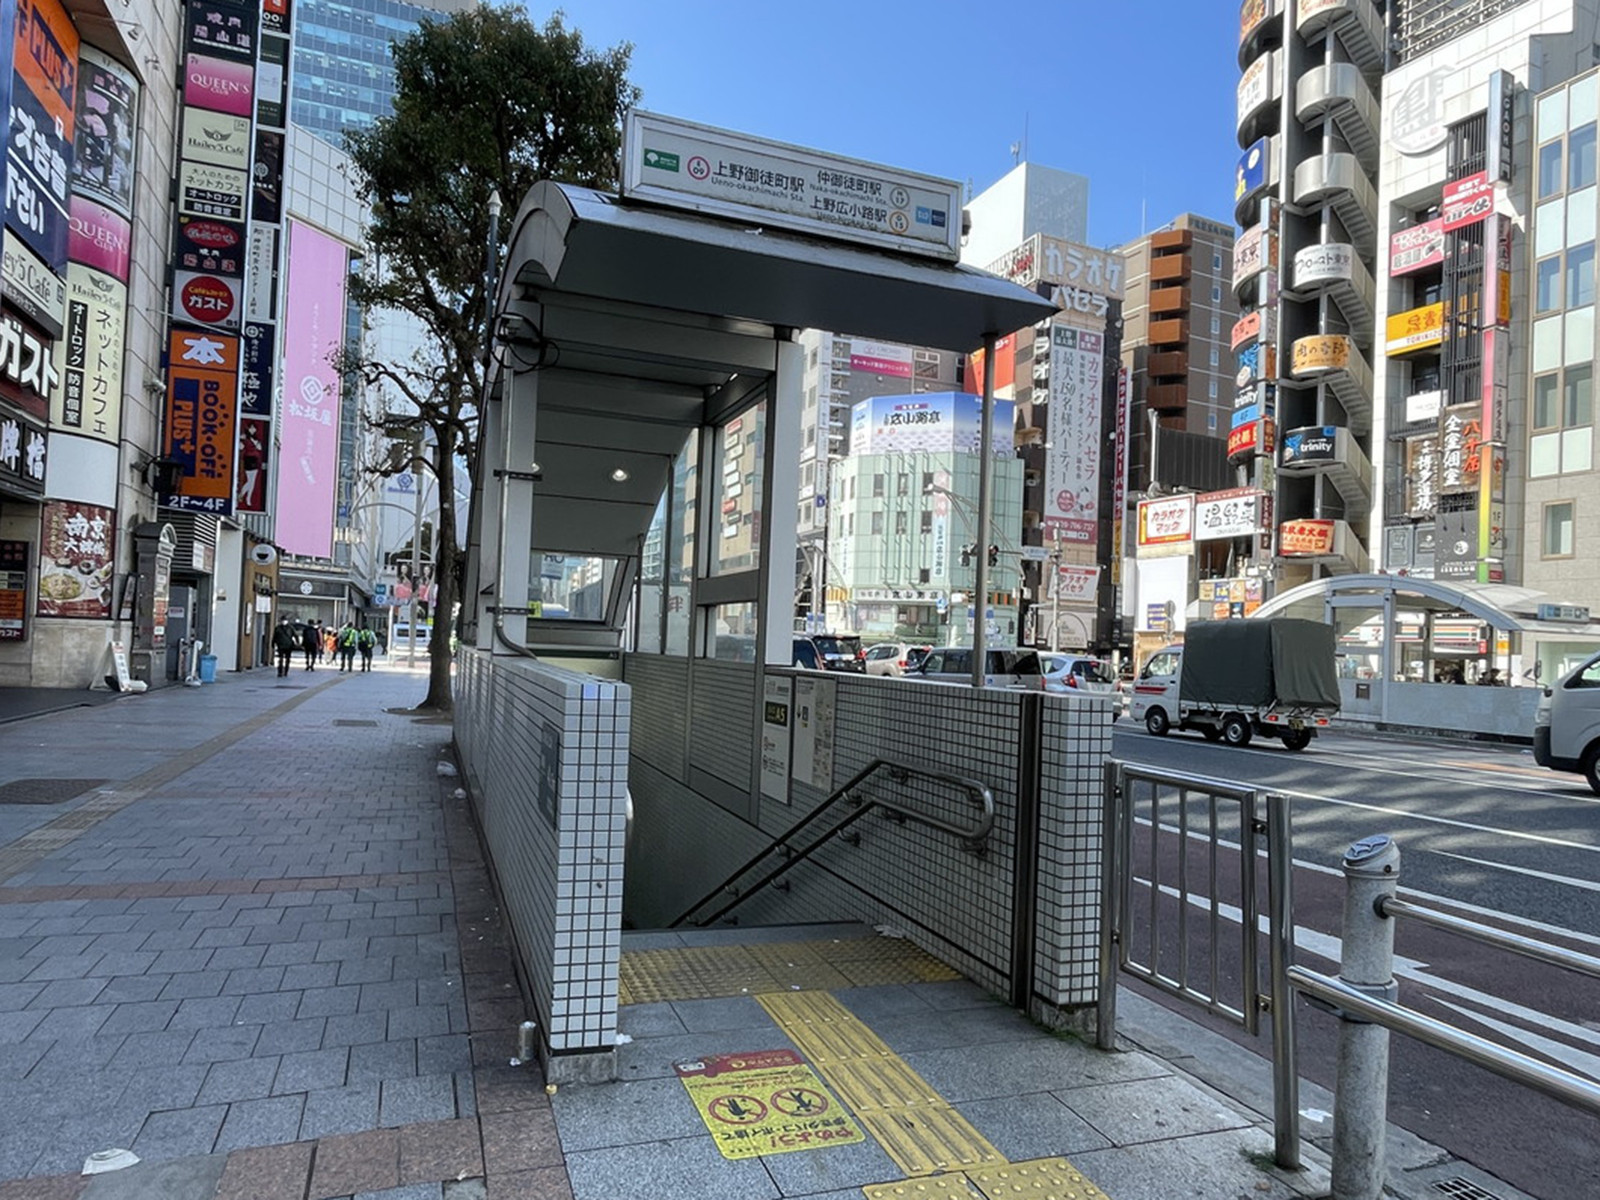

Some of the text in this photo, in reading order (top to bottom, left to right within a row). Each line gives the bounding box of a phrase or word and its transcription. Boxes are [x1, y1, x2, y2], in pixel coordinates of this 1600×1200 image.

[190, 73, 249, 94] QUEEN'S
[186, 175, 243, 193] ネットカフェ
[711, 176, 788, 199] Ueno-okachimachi
[713, 160, 805, 193] 上野御徒町駅
[817, 170, 882, 196] 仲御徒町駅
[189, 188, 238, 204] オートロック
[810, 195, 887, 222] 上野広小路駅
[69, 216, 128, 255] QUEEN'S
[1045, 242, 1121, 294] カラオケ
[188, 295, 228, 311] ガスト
[1051, 285, 1109, 317] パセラ
[70, 303, 85, 365] オートロック
[0, 317, 58, 398] ガスト
[182, 337, 225, 364] 本
[92, 309, 112, 435] ネットカフェ
[66, 373, 81, 424] 防音個室
[288, 399, 332, 427] 松坂屋
[1300, 442, 1332, 452] trinity
[1443, 414, 1462, 487] 全室個室
[1203, 499, 1256, 529] 温野菜
